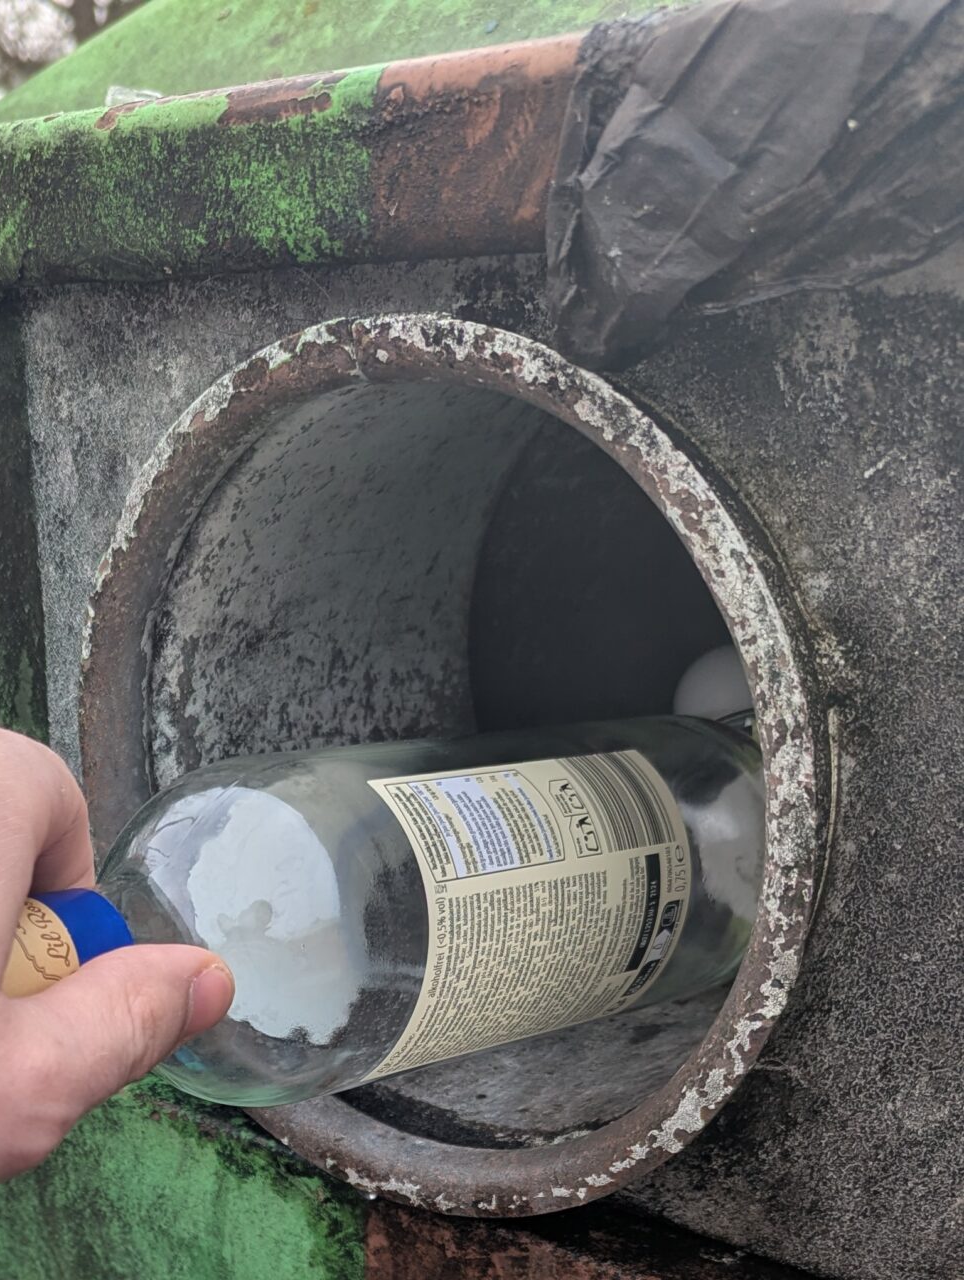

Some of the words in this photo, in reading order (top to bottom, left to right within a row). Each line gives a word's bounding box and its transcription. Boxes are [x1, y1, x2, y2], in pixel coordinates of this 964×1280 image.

[674, 869, 687, 892] 0,75
[436, 896, 446, 914] vol)
[436, 916, 447, 949] (<0,5%
[428, 952, 445, 998] alkoholfrei
